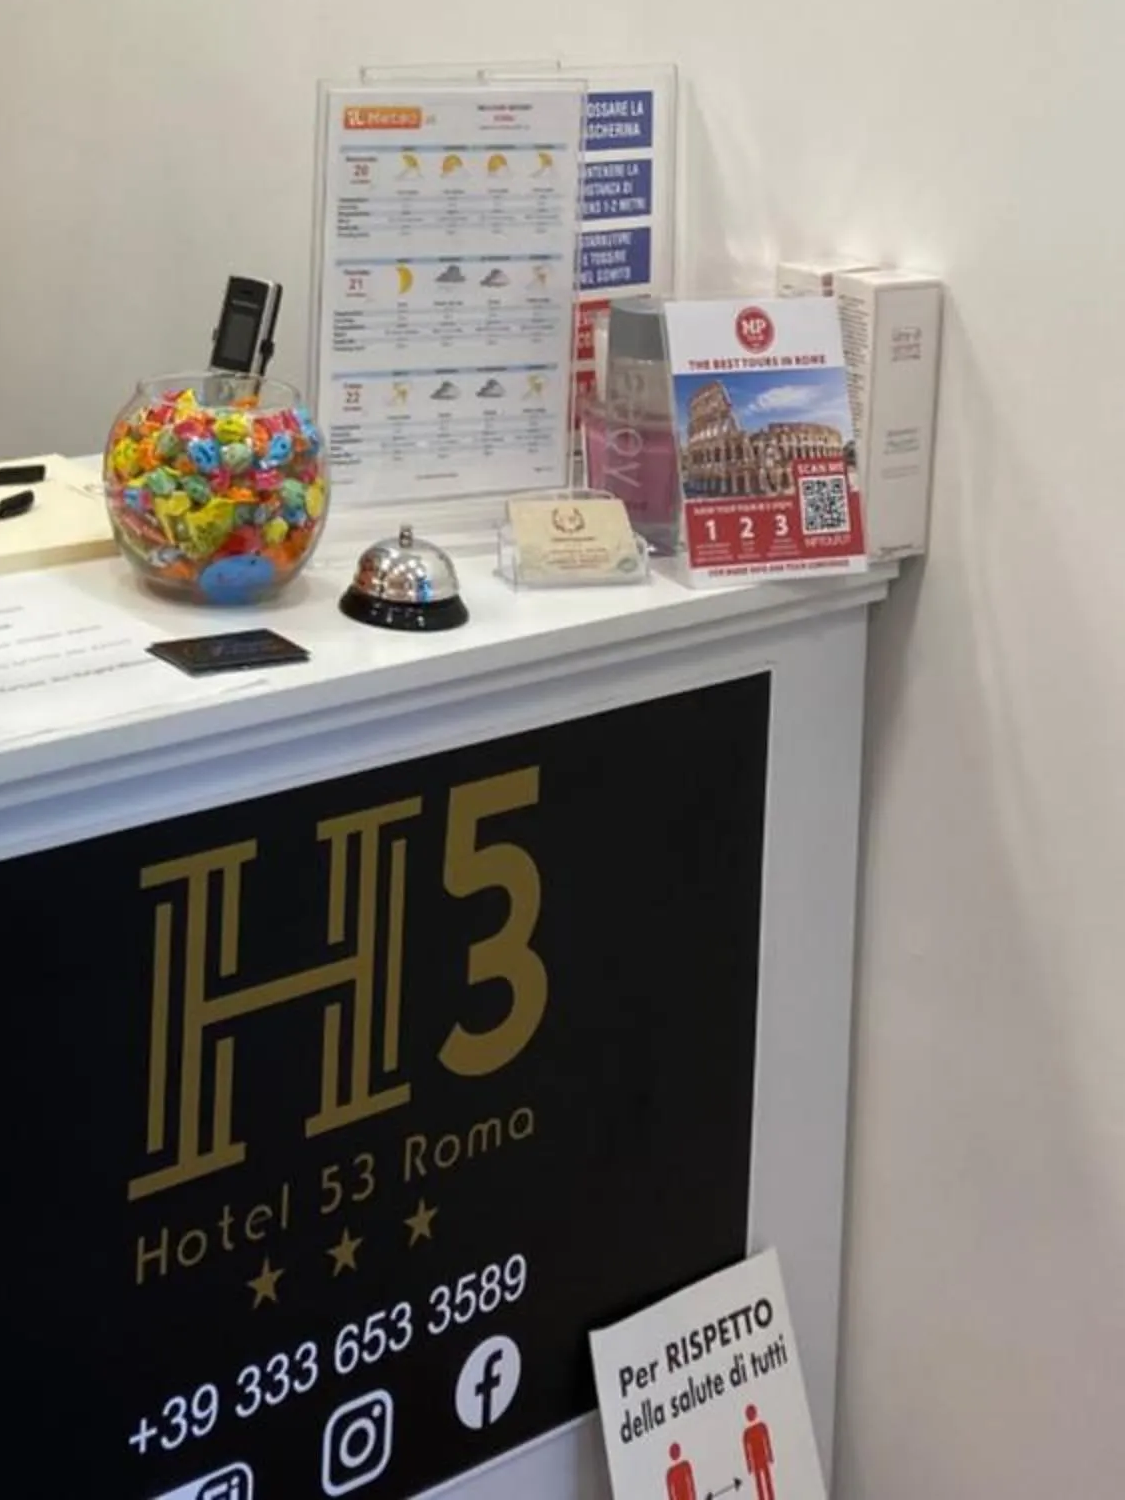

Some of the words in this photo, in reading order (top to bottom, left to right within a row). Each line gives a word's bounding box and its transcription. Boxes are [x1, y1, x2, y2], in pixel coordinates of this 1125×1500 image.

[587, 100, 628, 117] OSSARE
[688, 359, 710, 370] THE
[713, 357, 740, 369] BEST
[742, 356, 779, 368] TOURS
[781, 355, 792, 366] IN
[795, 354, 826, 365] ROME
[797, 463, 826, 475] SCAN
[704, 518, 717, 541] 1
[739, 516, 755, 540] 2
[774, 514, 789, 537] 3
[135, 1185, 290, 1286] Hotel
[319, 1152, 377, 1213] 53
[403, 1106, 536, 1182] Roma
[128, 1385, 219, 1456] +39
[235, 1341, 318, 1419] 333
[333, 1302, 413, 1376] 653
[427, 1253, 527, 1334] 3589
[618, 1360, 659, 1398] Per
[665, 1298, 774, 1374] RISPETTO
[620, 1400, 666, 1444] della
[670, 1375, 725, 1419] salute
[729, 1352, 748, 1388] di
[751, 1333, 789, 1379] tutti
